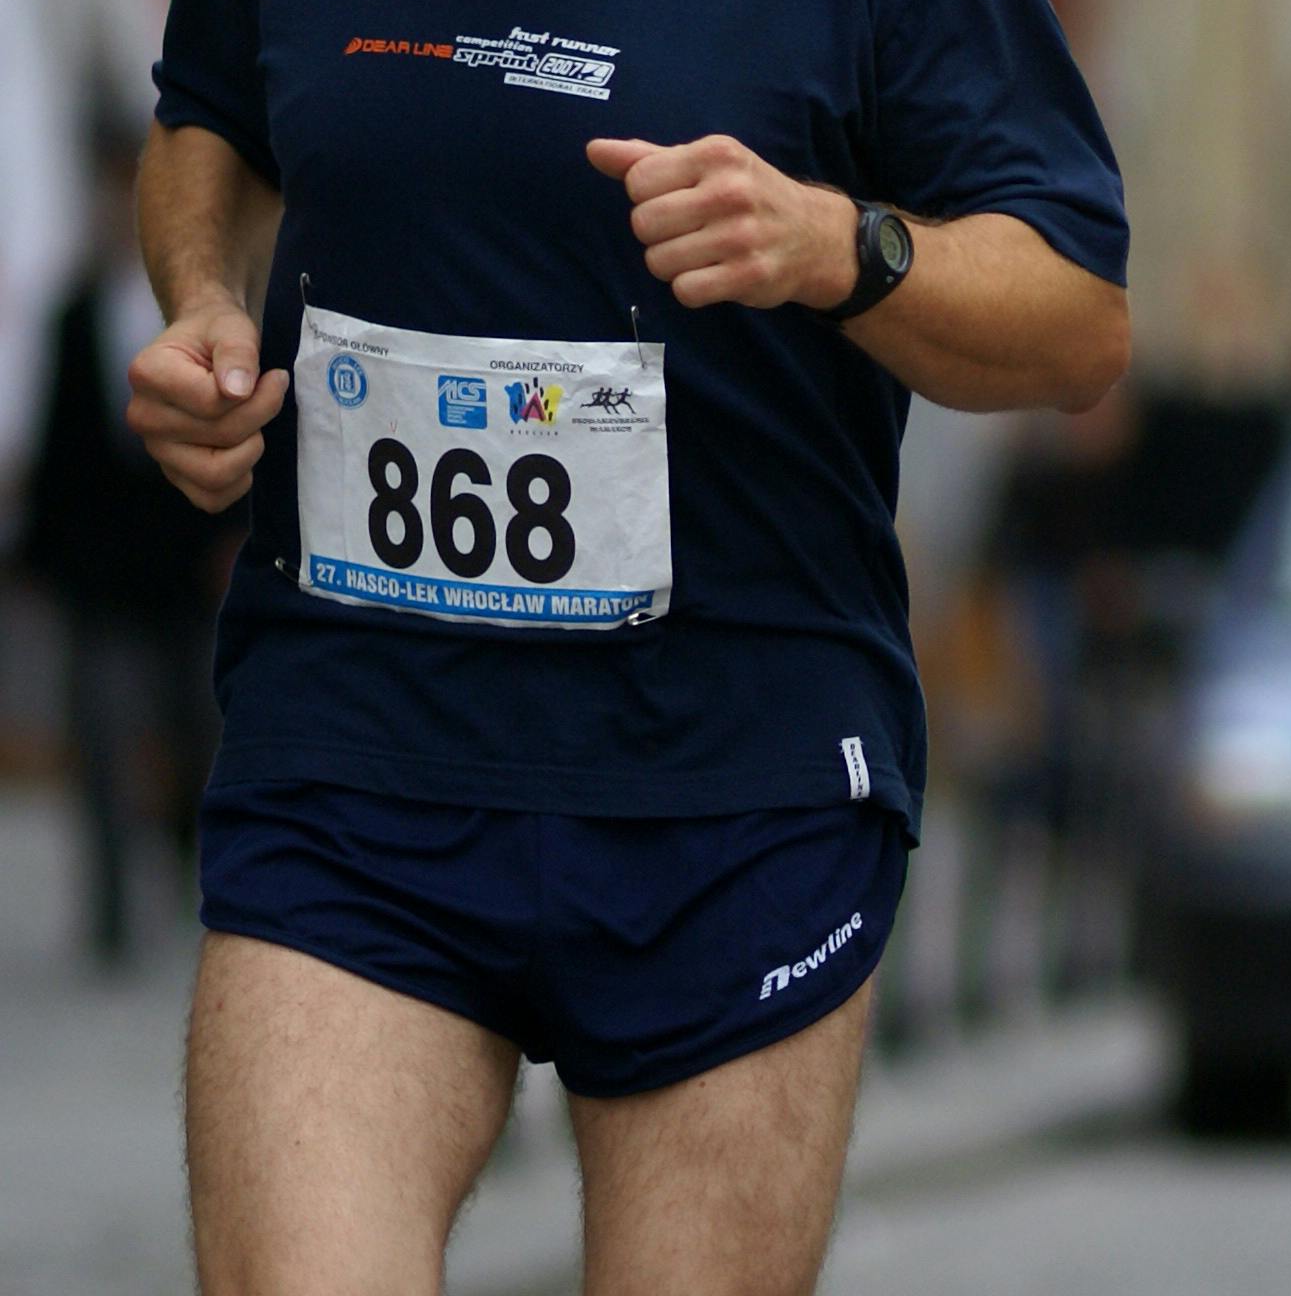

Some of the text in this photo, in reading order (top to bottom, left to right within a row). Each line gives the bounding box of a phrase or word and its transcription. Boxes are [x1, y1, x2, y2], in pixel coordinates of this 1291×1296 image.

[413, 43, 454, 57] LINE
[456, 35, 533, 53] competition
[551, 37, 621, 56] runner
[453, 48, 540, 72] sprint
[489, 360, 585, 374] ORGANIZATORZY
[368, 437, 576, 584] 868
[316, 562, 342, 586] 27.
[347, 568, 438, 604] HASCO-LEK
[443, 586, 545, 615] WROCŁAW
